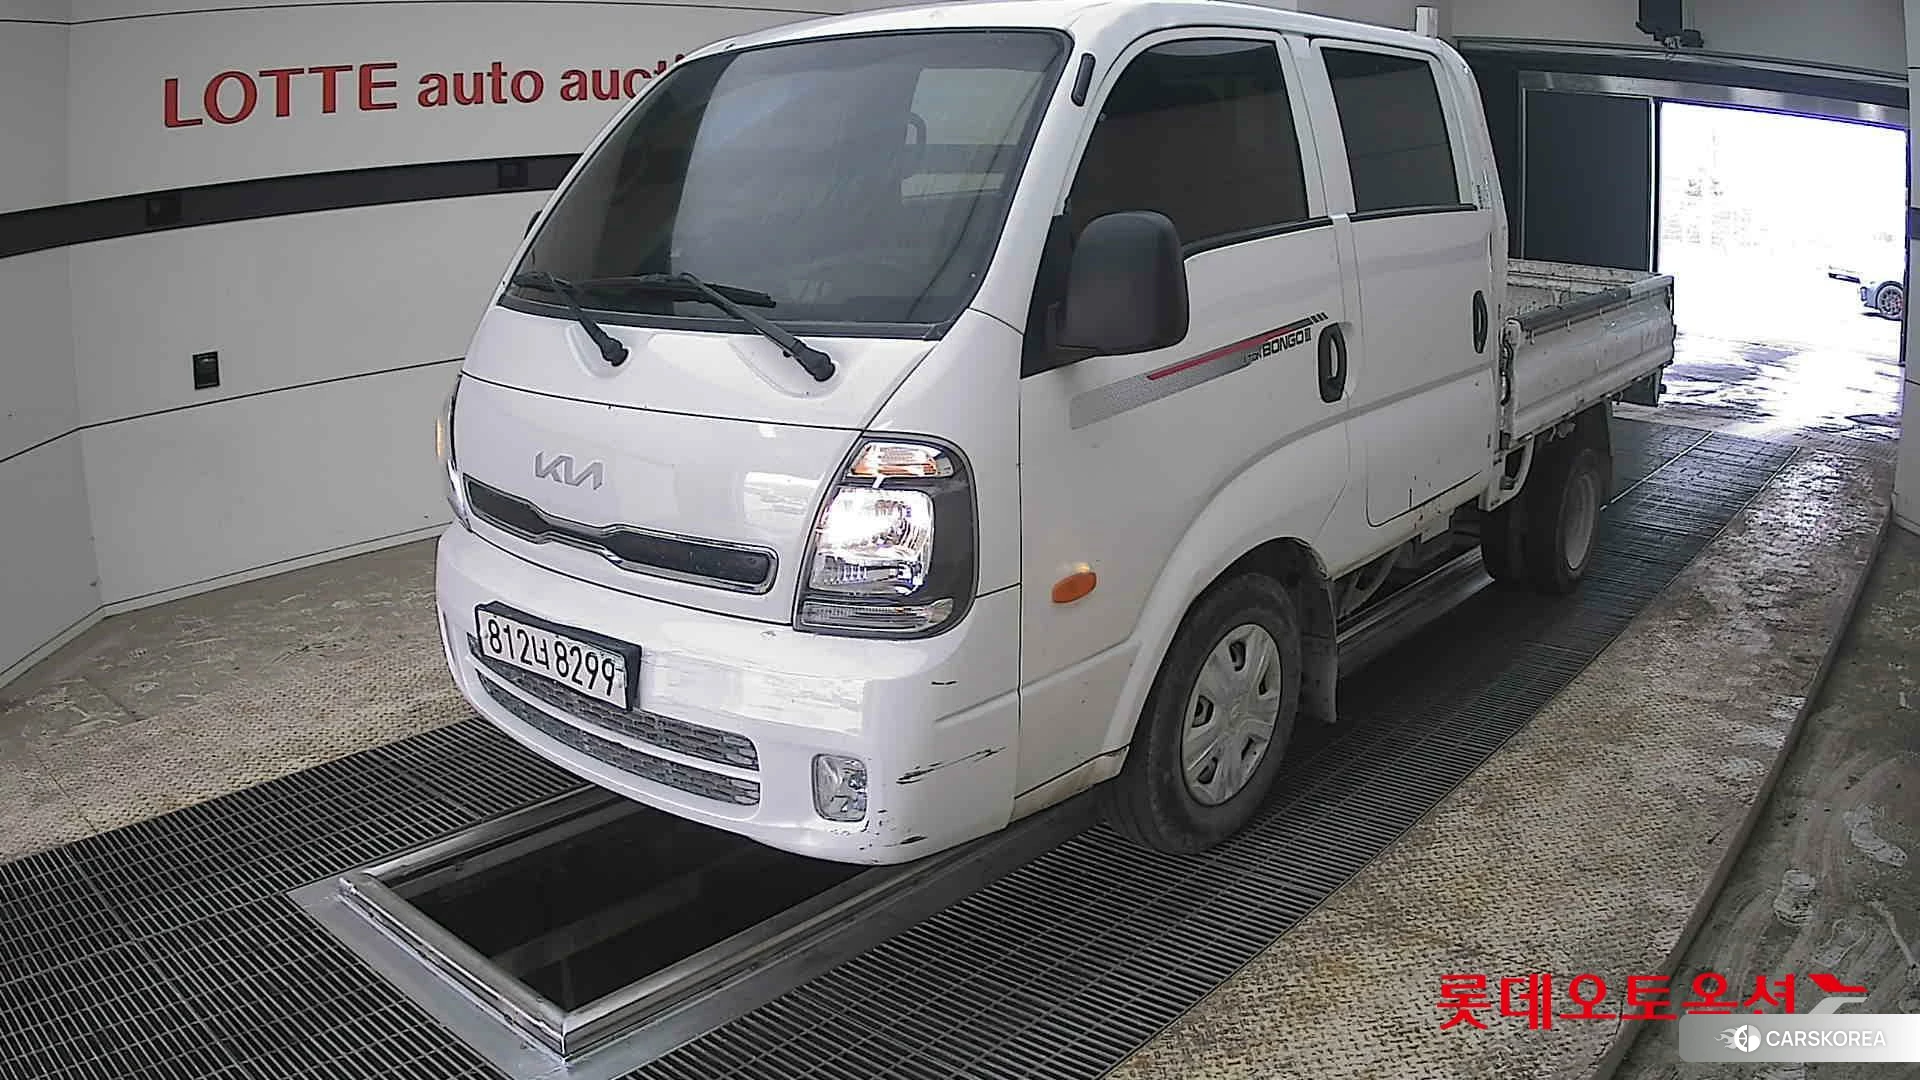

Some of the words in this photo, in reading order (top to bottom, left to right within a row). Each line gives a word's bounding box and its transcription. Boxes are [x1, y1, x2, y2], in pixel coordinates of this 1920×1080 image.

[164, 62, 397, 127] LOTTE
[417, 61, 545, 107] auto
[1262, 330, 1304, 357] BONGO
[535, 451, 603, 490] KIA
[554, 641, 615, 696] 8299
